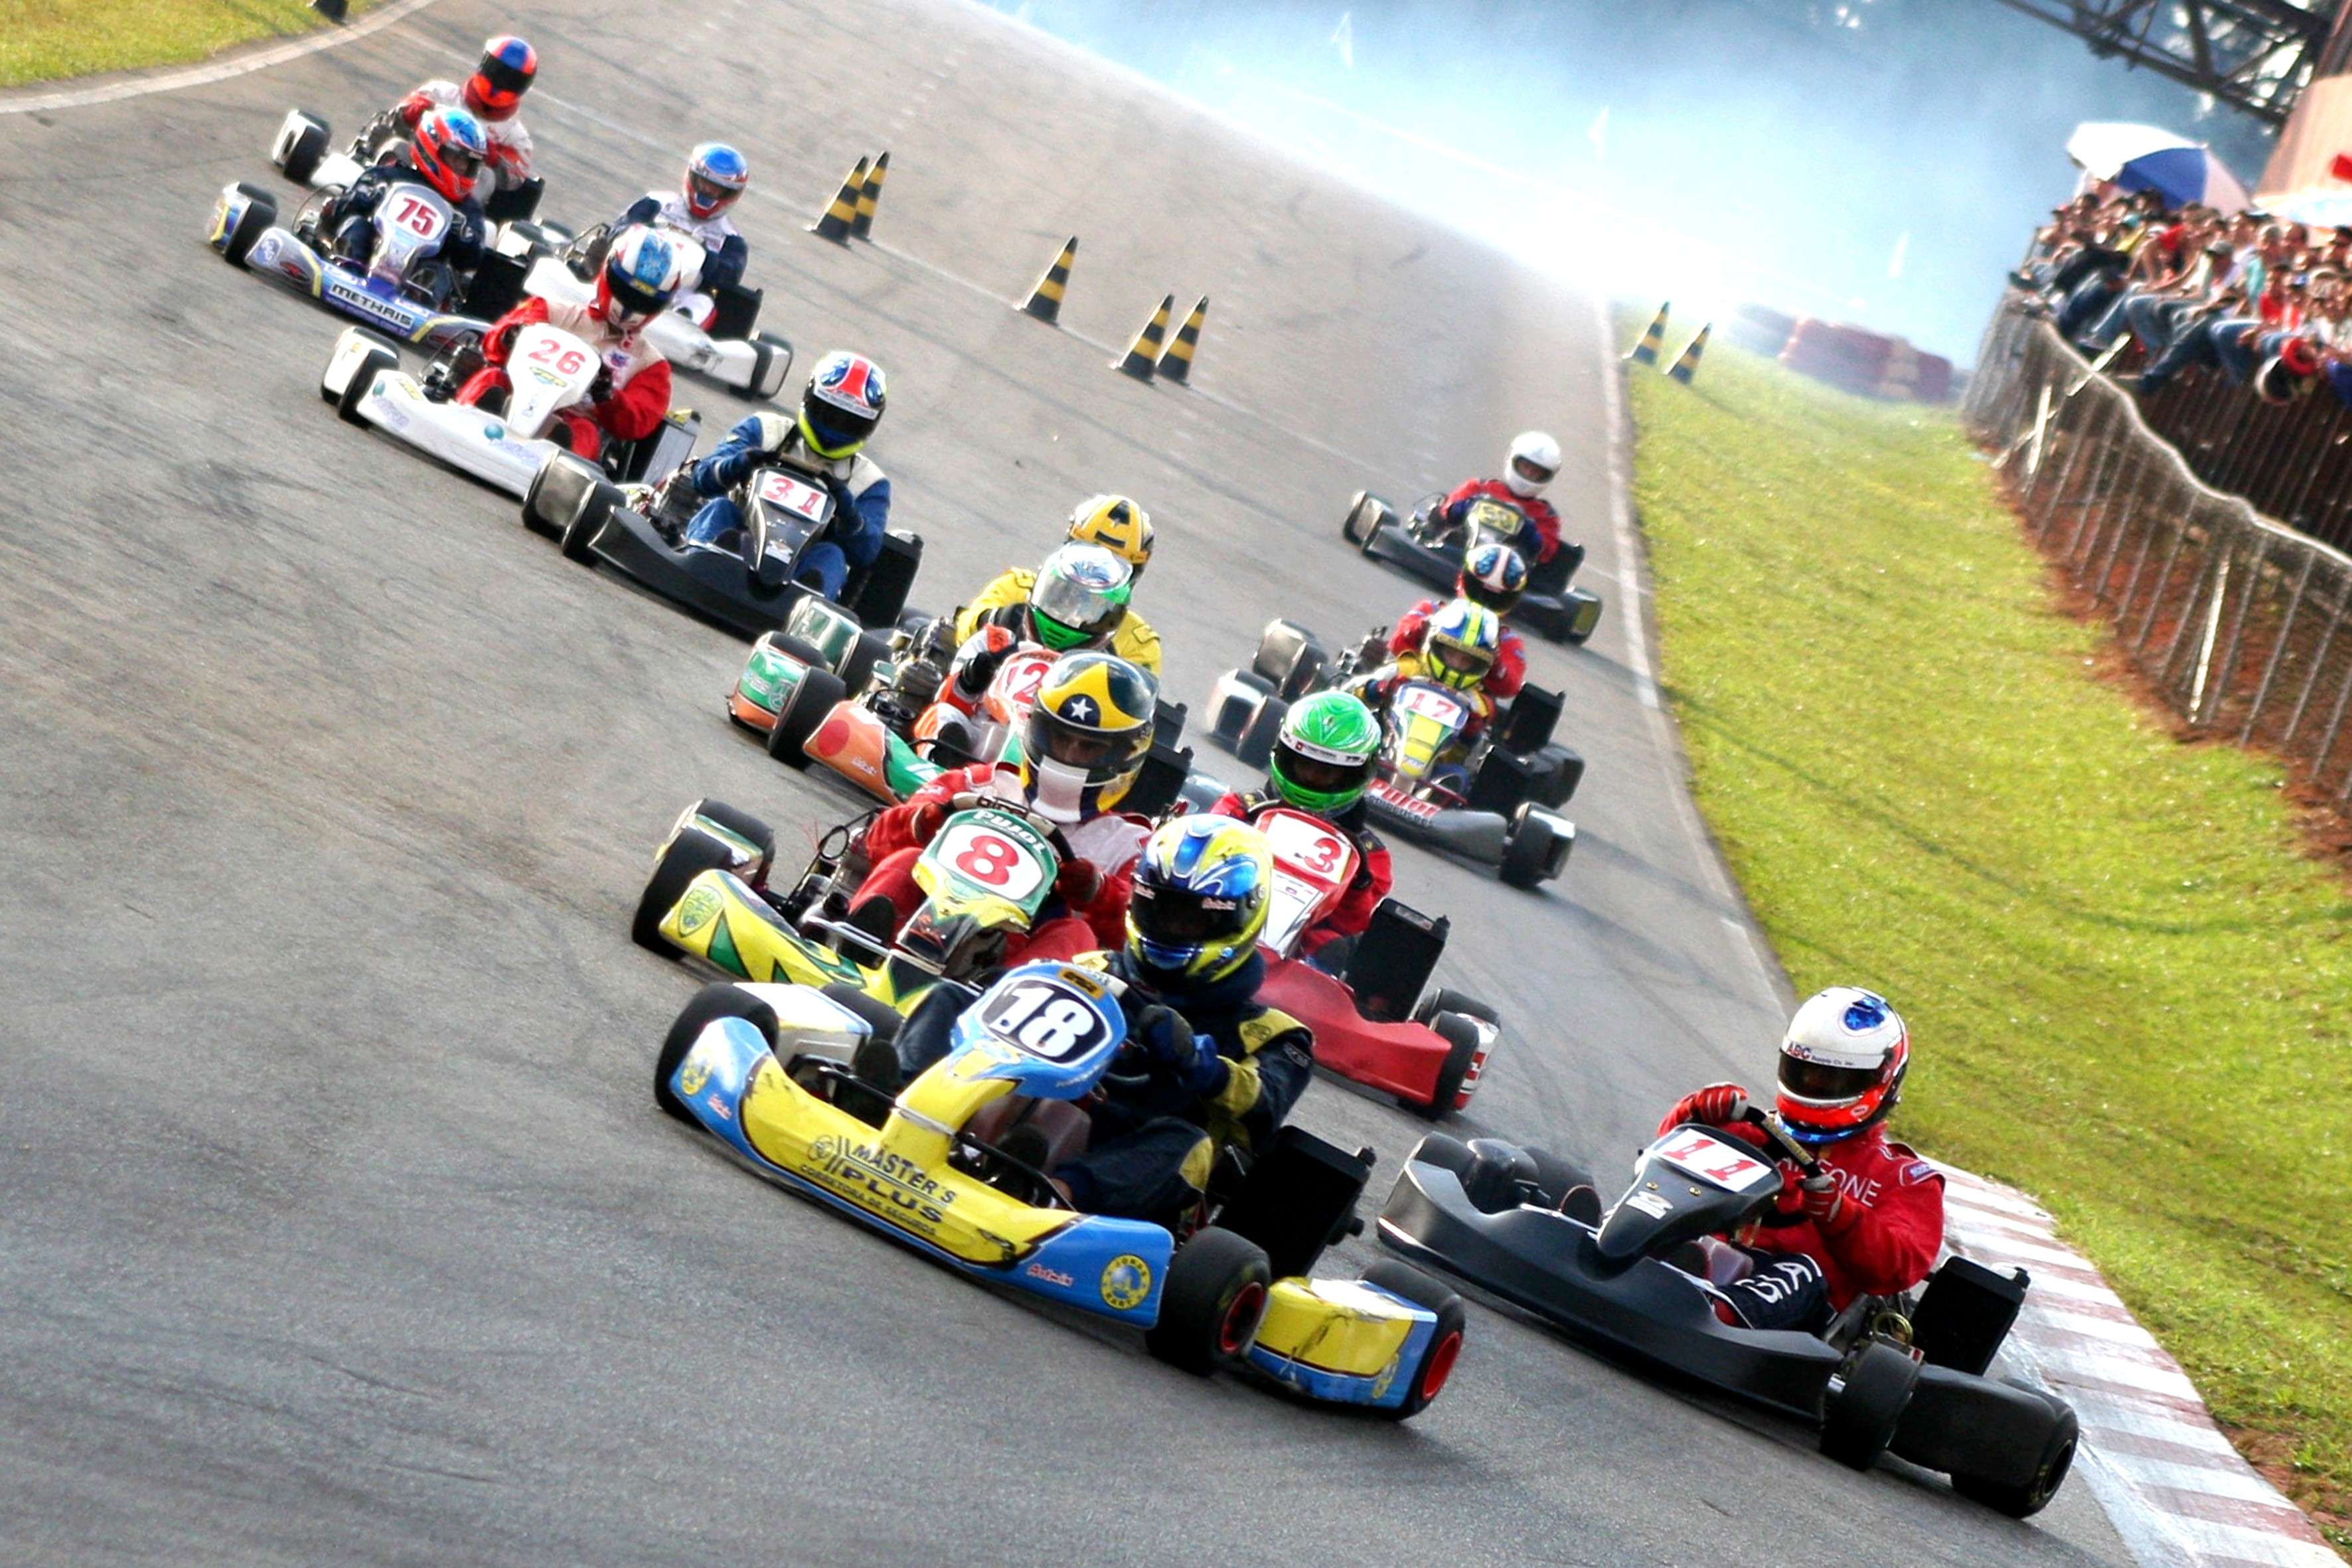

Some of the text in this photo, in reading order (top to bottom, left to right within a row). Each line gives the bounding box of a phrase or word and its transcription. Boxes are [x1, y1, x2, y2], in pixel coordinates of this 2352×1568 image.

[396, 197, 437, 237] 75
[528, 339, 586, 375] 26
[764, 477, 822, 516] 31
[1406, 693, 1457, 718] 17
[955, 835, 1020, 886] 8
[989, 984, 1095, 1058] 18
[1786, 1042, 1811, 1059] ABC
[1662, 1138, 1759, 1182] 11
[841, 1166, 943, 1223] PLUS
